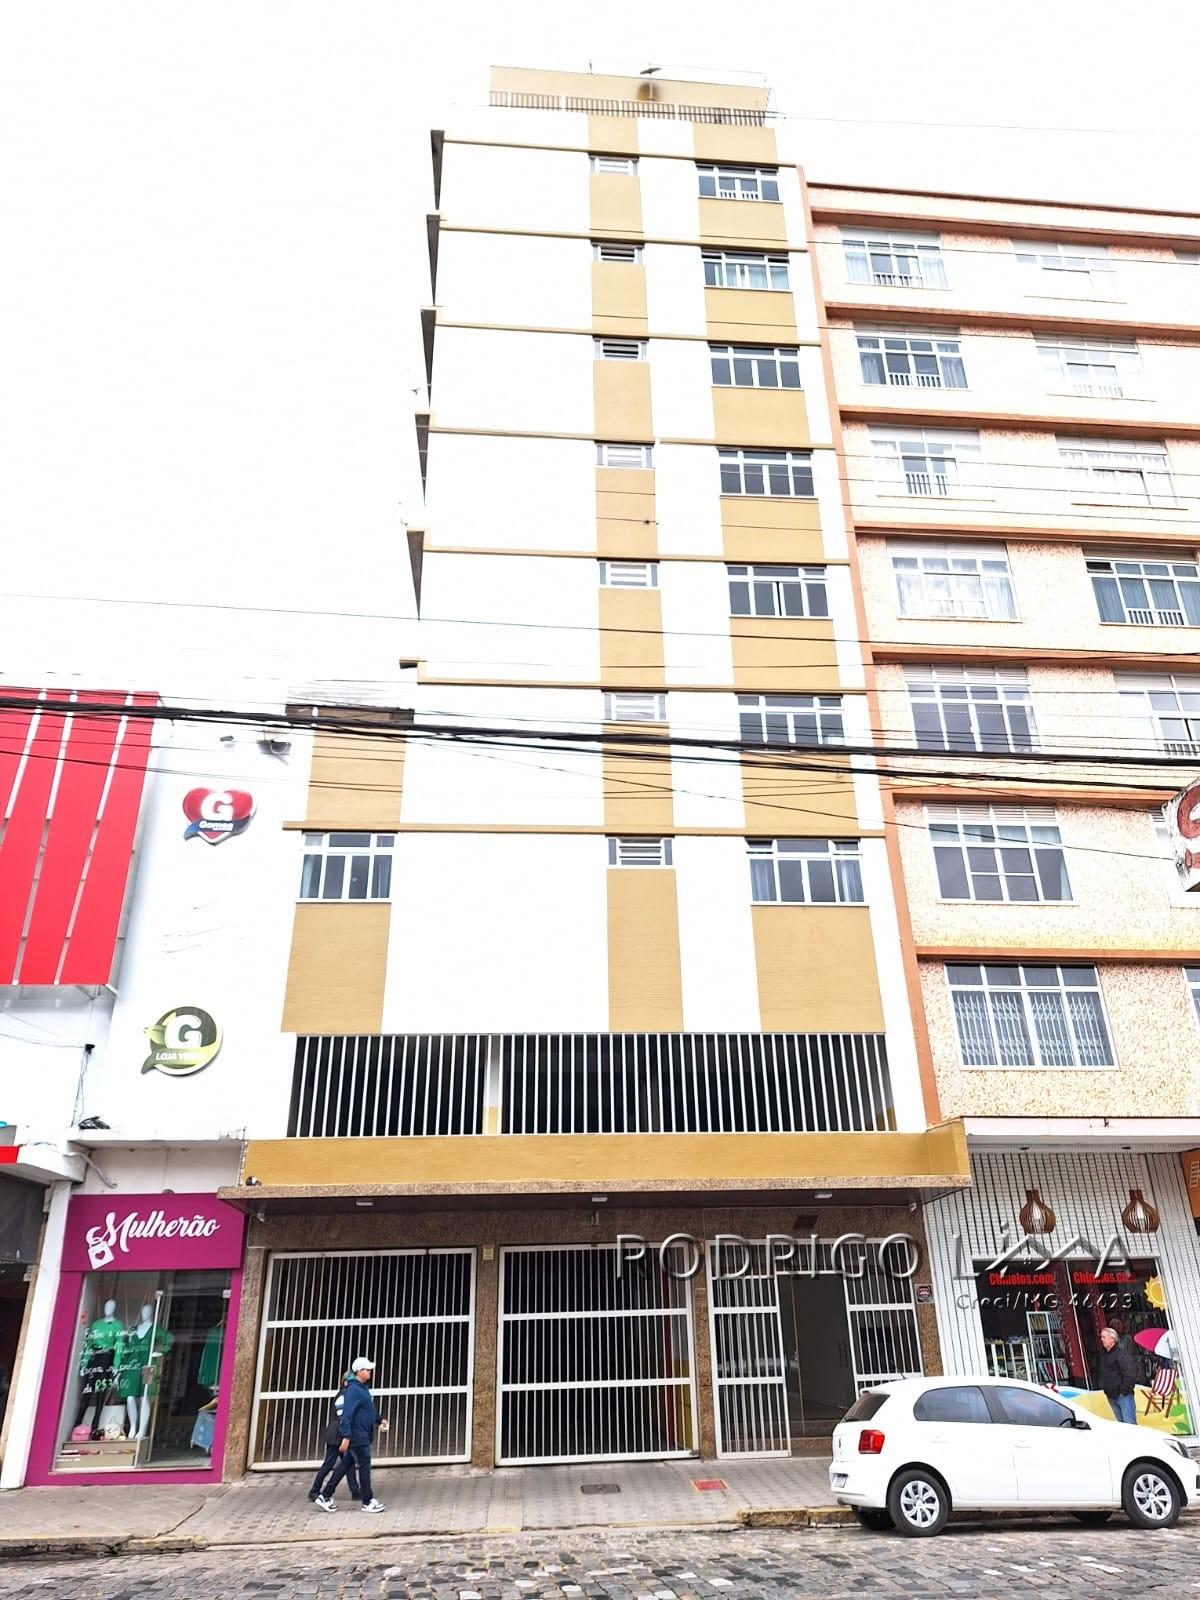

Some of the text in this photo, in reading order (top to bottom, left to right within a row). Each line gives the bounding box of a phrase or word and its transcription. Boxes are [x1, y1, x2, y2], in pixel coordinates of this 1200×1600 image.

[164, 1014, 203, 1049] G
[155, 1052, 177, 1061] LOJA
[86, 1210, 220, 1253] Mulherão
